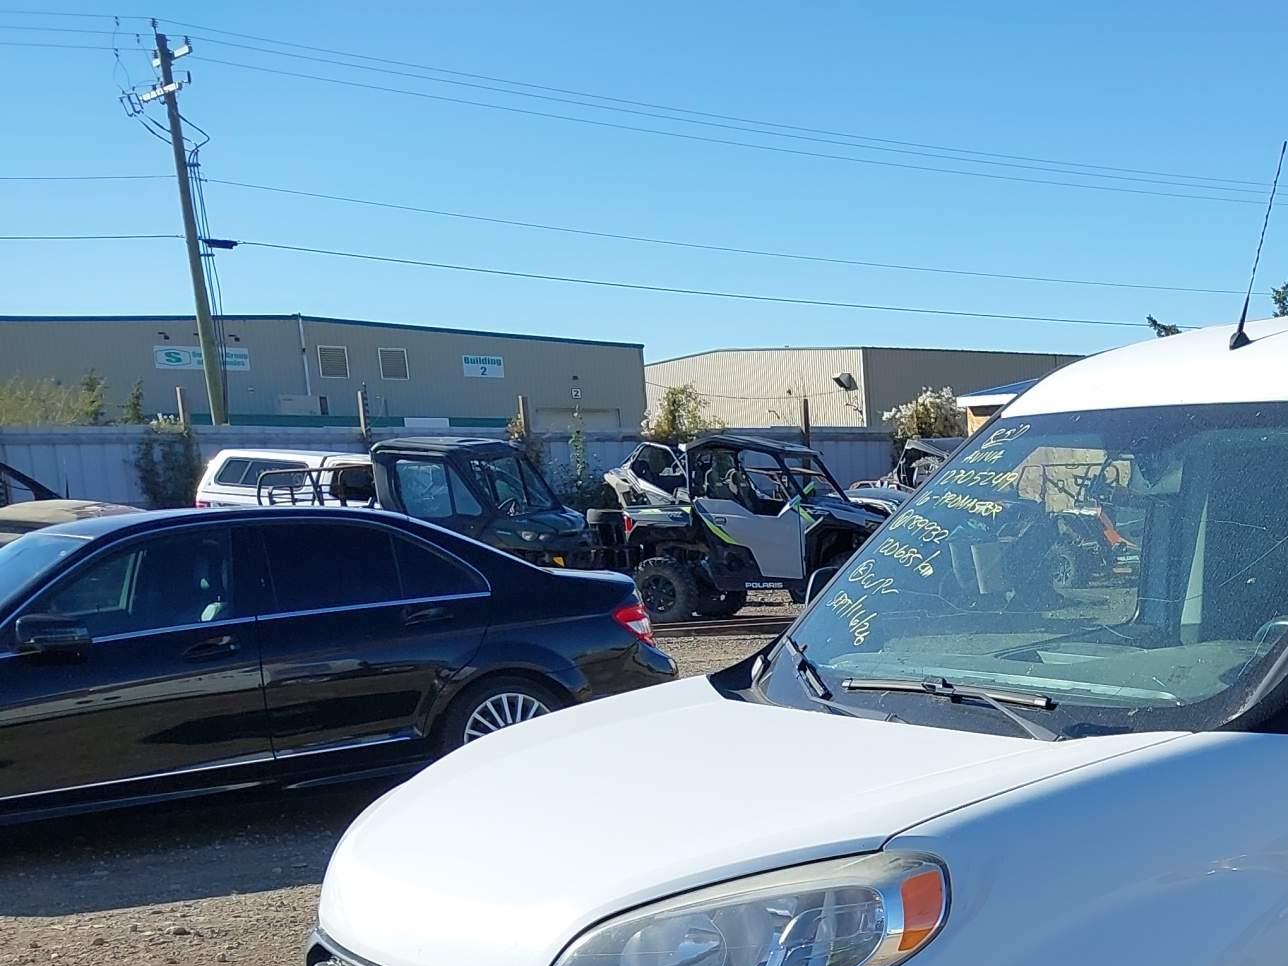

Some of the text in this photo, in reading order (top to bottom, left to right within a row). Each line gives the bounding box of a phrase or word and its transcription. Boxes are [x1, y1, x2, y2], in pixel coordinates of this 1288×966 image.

[164, 351, 183, 363] S
[463, 356, 502, 367] Building
[480, 366, 488, 376] 2
[745, 581, 784, 589] POLARIS
